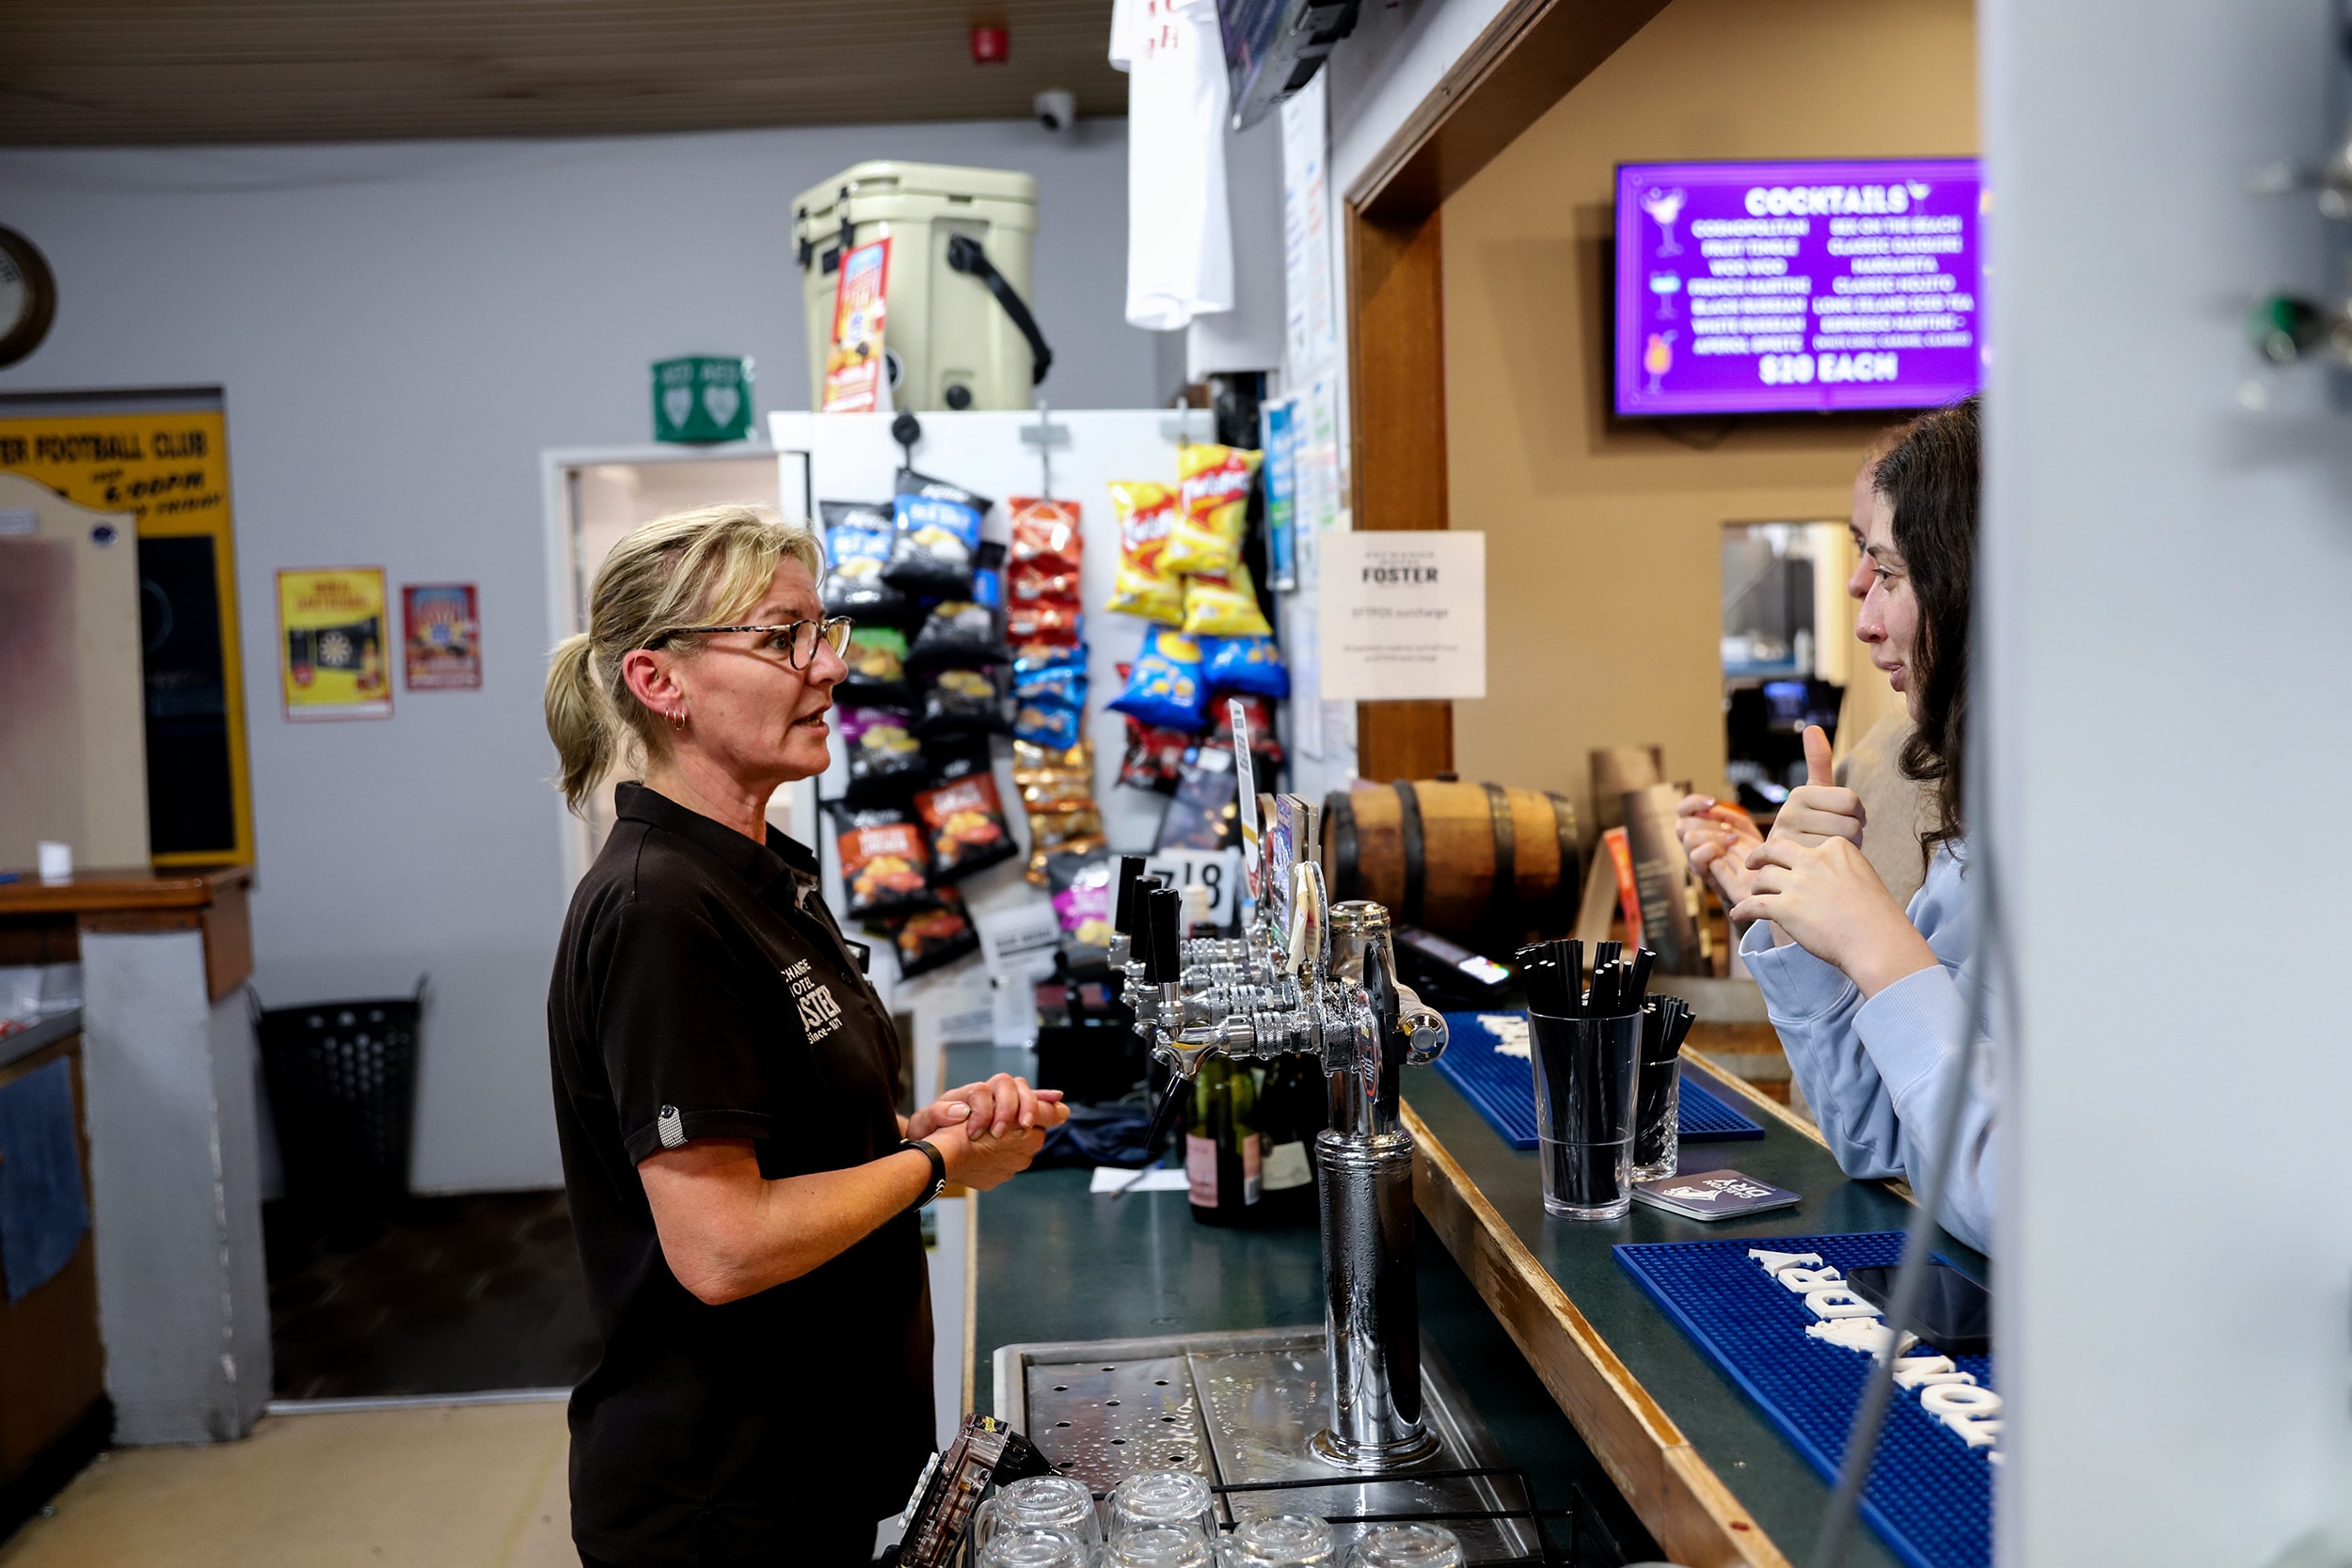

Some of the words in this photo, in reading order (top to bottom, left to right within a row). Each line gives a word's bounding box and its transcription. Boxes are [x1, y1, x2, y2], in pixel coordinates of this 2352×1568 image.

[1744, 184, 1910, 216] COCKTAILS
[1817, 353, 1899, 382] EACH
[152, 432, 207, 458] CLUB
[1362, 567, 1438, 583] FOSTER
[789, 976, 815, 998] OTEL
[1716, 1179, 1773, 1197] DRY
[1748, 1248, 1885, 1320] DRY
